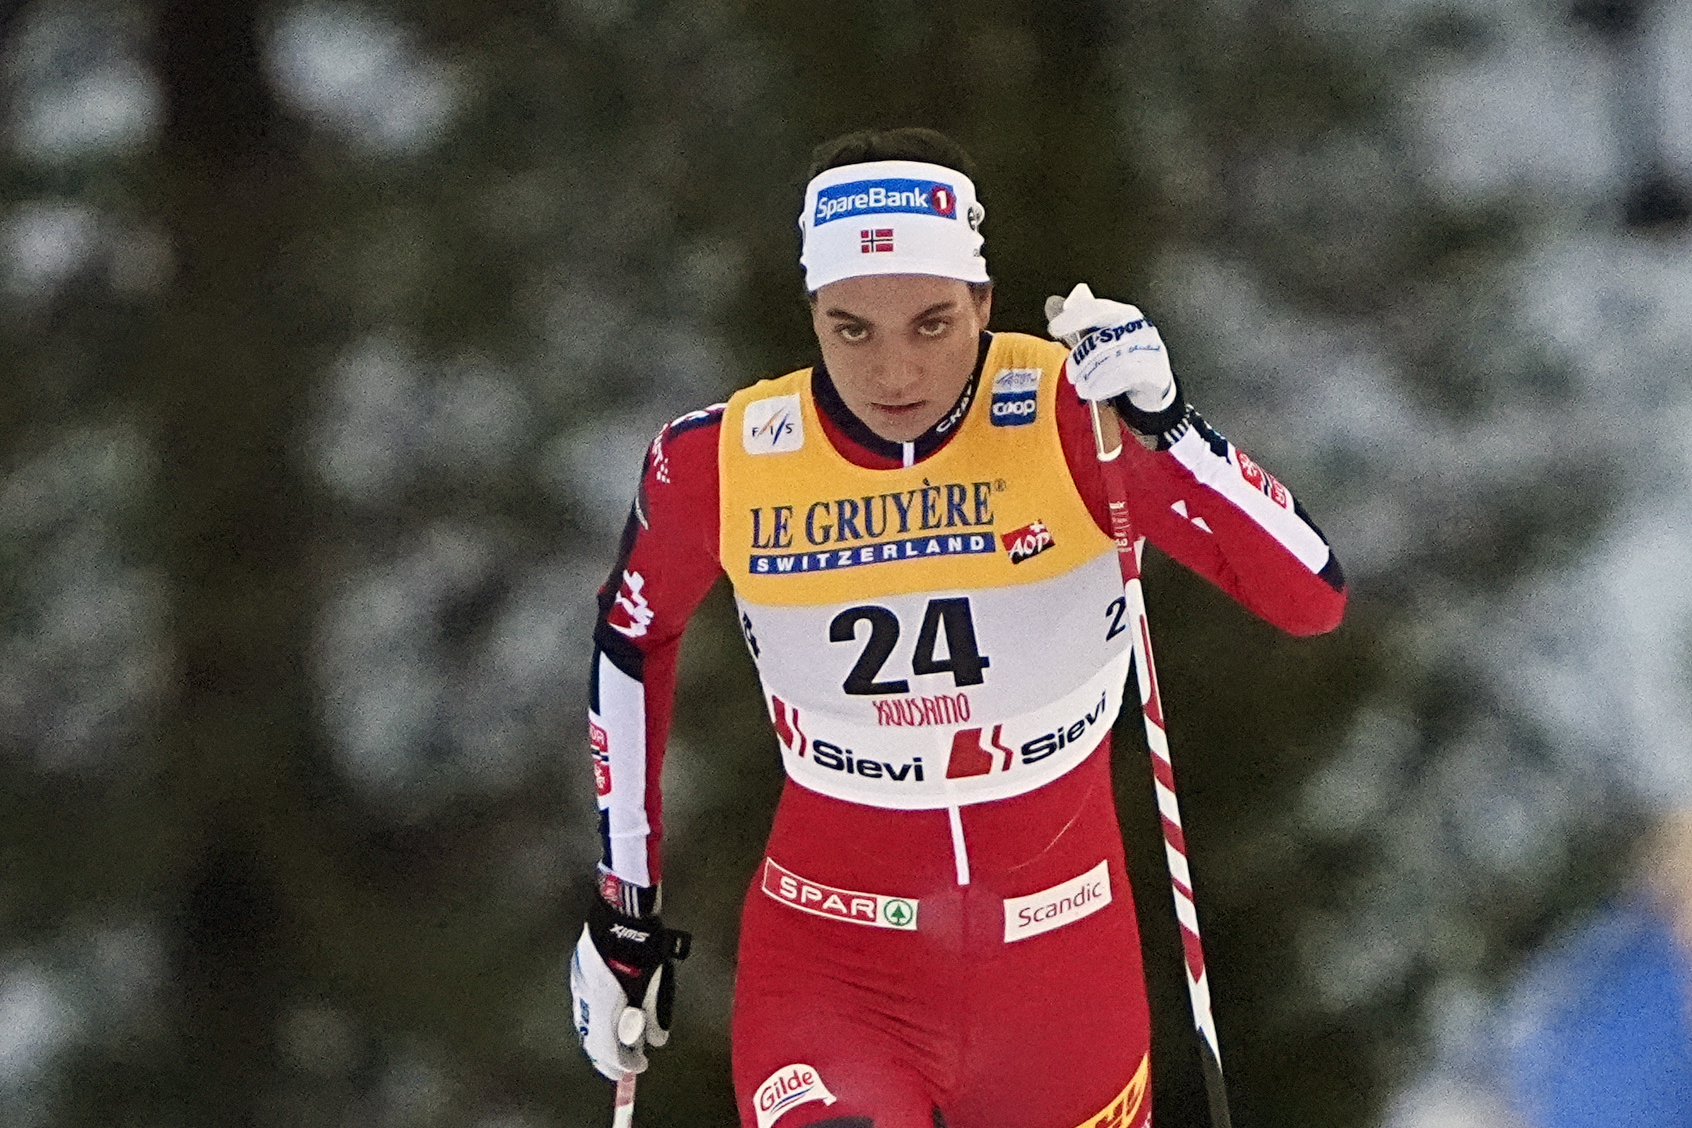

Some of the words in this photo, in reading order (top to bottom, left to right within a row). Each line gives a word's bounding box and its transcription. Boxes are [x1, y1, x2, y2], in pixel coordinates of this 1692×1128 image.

[816, 187, 929, 220] SpareBank
[992, 399, 1037, 417] coop
[749, 504, 794, 549] LE
[1009, 532, 1051, 560] AOP
[756, 535, 986, 573] SWITZERLAND
[1105, 596, 1127, 642] 2
[828, 596, 990, 695] 24
[1020, 690, 1107, 765] Sievi
[812, 738, 925, 782] Sievi
[778, 875, 877, 920] SPAR
[1017, 880, 1103, 928] Scandic
[760, 1069, 815, 1112] Gilde
